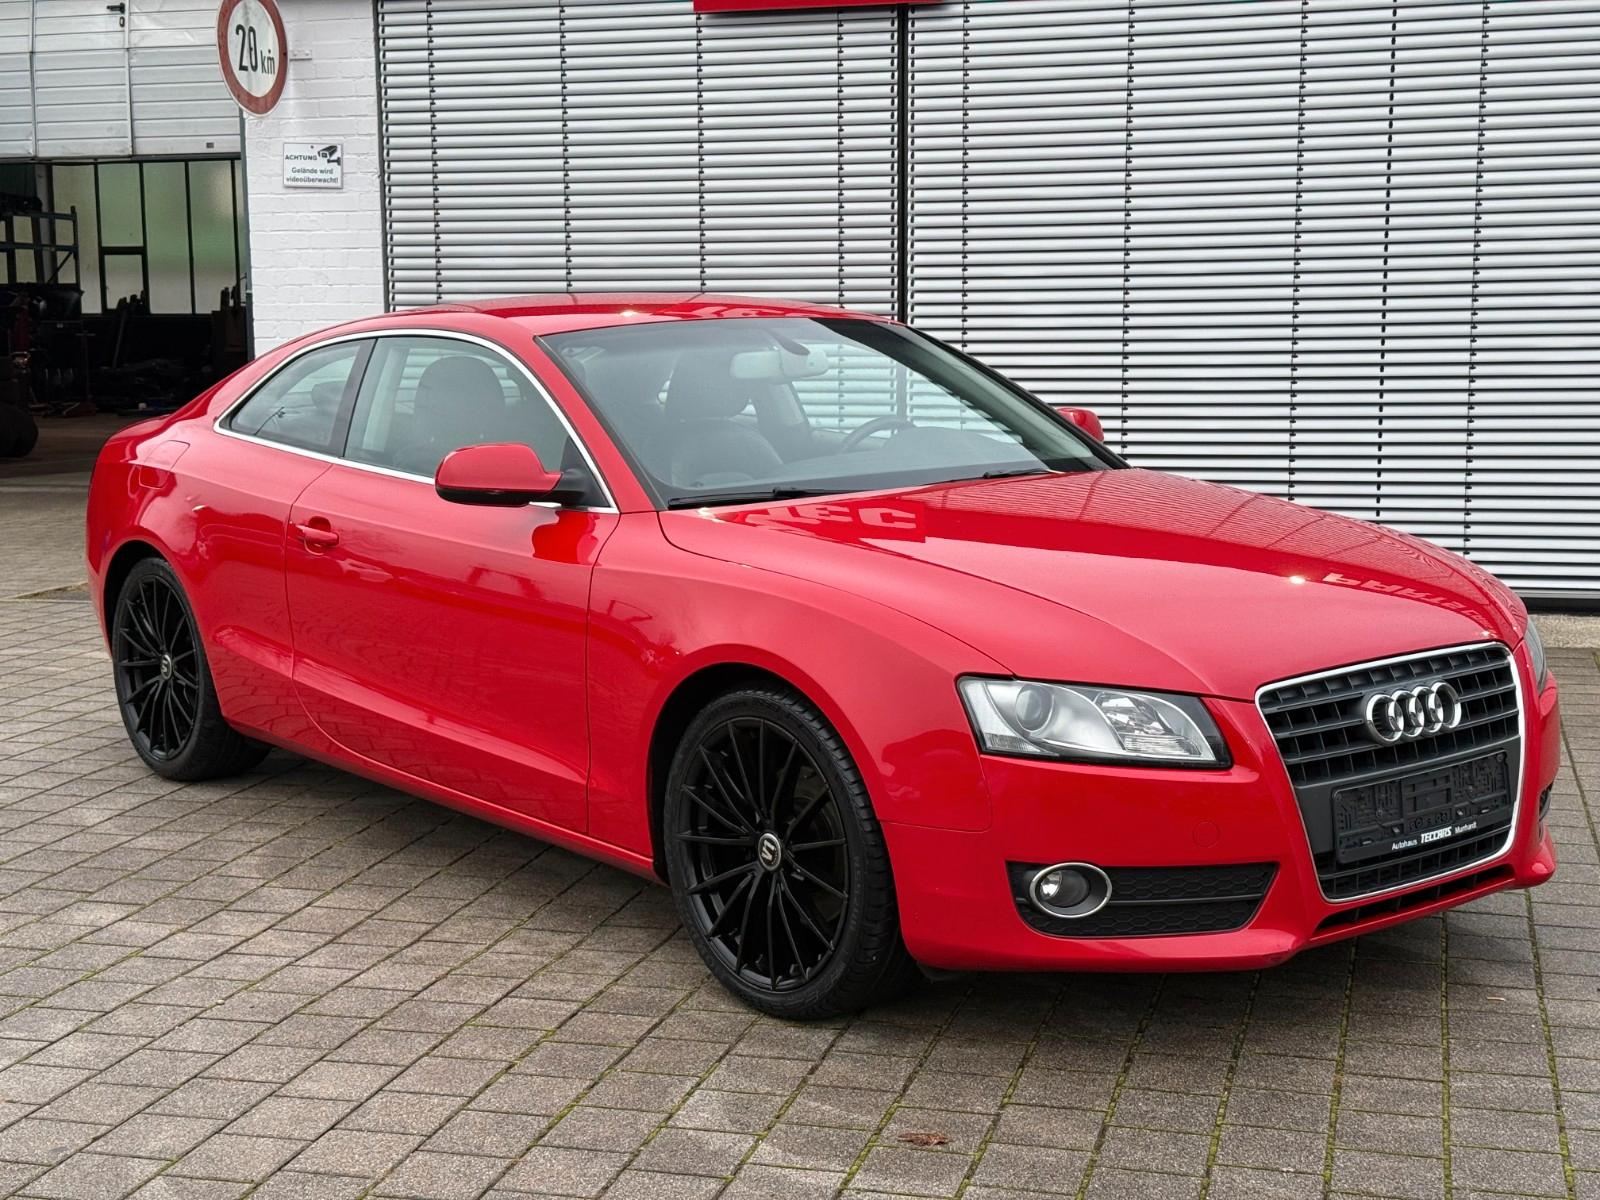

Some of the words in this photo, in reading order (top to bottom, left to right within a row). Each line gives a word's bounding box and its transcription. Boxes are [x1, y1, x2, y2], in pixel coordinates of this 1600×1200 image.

[235, 24, 258, 72] 20
[260, 50, 275, 75] km
[286, 176, 339, 184] videoüberwacht!
[1392, 839, 1418, 851] Autohaus
[1420, 826, 1453, 844] TECCARS
